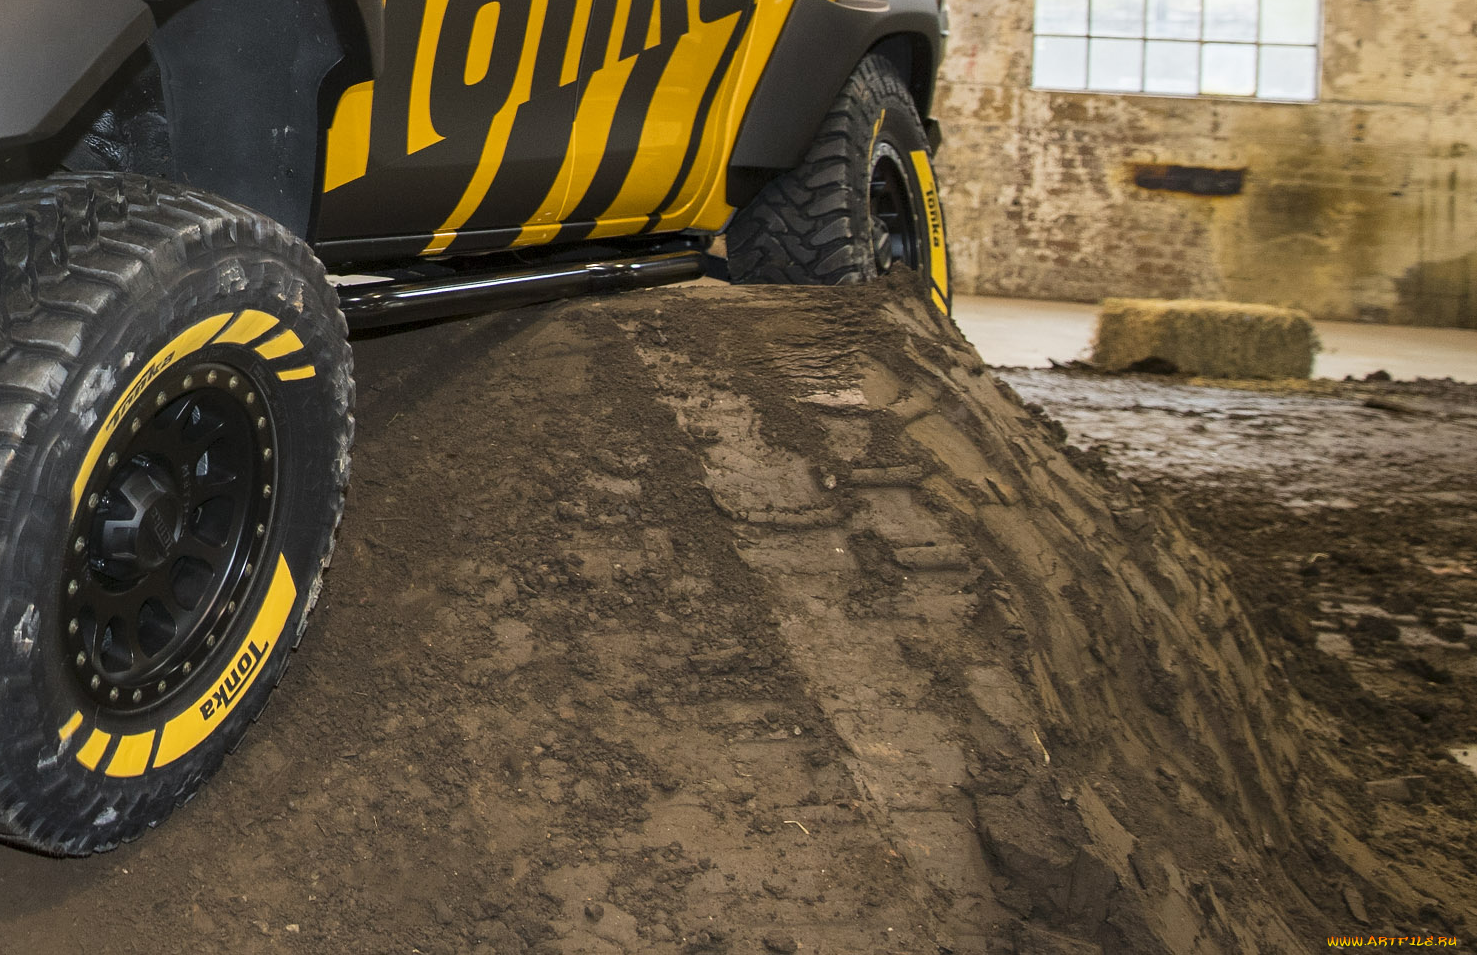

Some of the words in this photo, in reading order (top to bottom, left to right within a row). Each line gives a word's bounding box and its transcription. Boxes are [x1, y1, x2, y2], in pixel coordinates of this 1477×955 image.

[926, 184, 941, 247] Tonka
[106, 349, 175, 431] Tonka
[199, 641, 270, 721] Tonka
